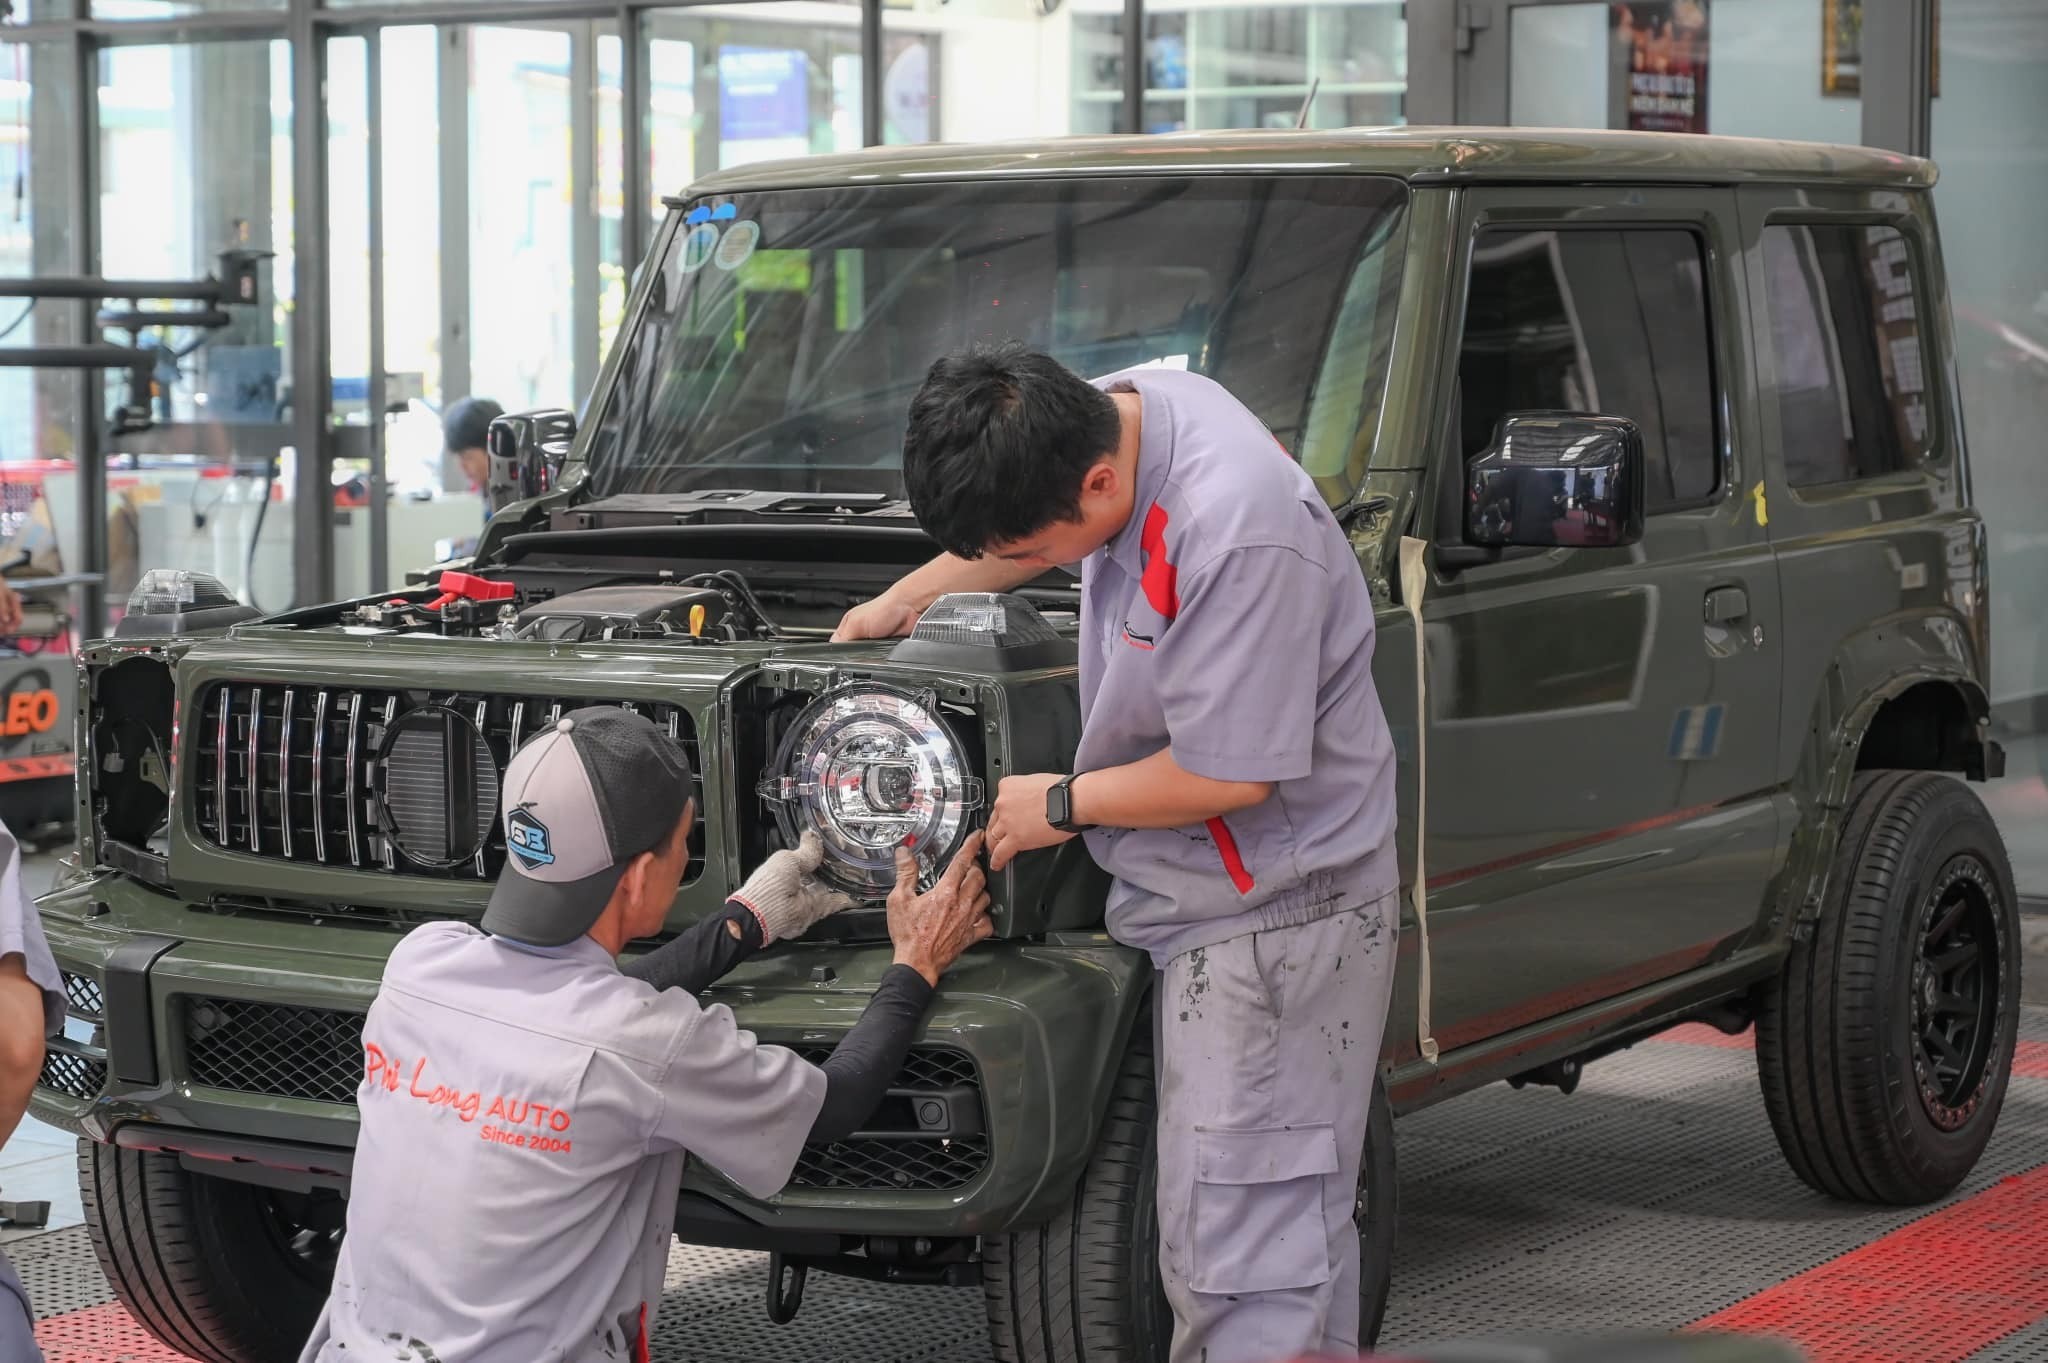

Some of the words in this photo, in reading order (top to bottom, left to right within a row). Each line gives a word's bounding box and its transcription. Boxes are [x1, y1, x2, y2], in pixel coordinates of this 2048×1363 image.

[366, 1042, 400, 1092] Phi
[410, 1057, 481, 1123] Long
[486, 1096, 571, 1132] AUTO
[480, 1124, 526, 1147] Since
[529, 1134, 572, 1153] 2004
